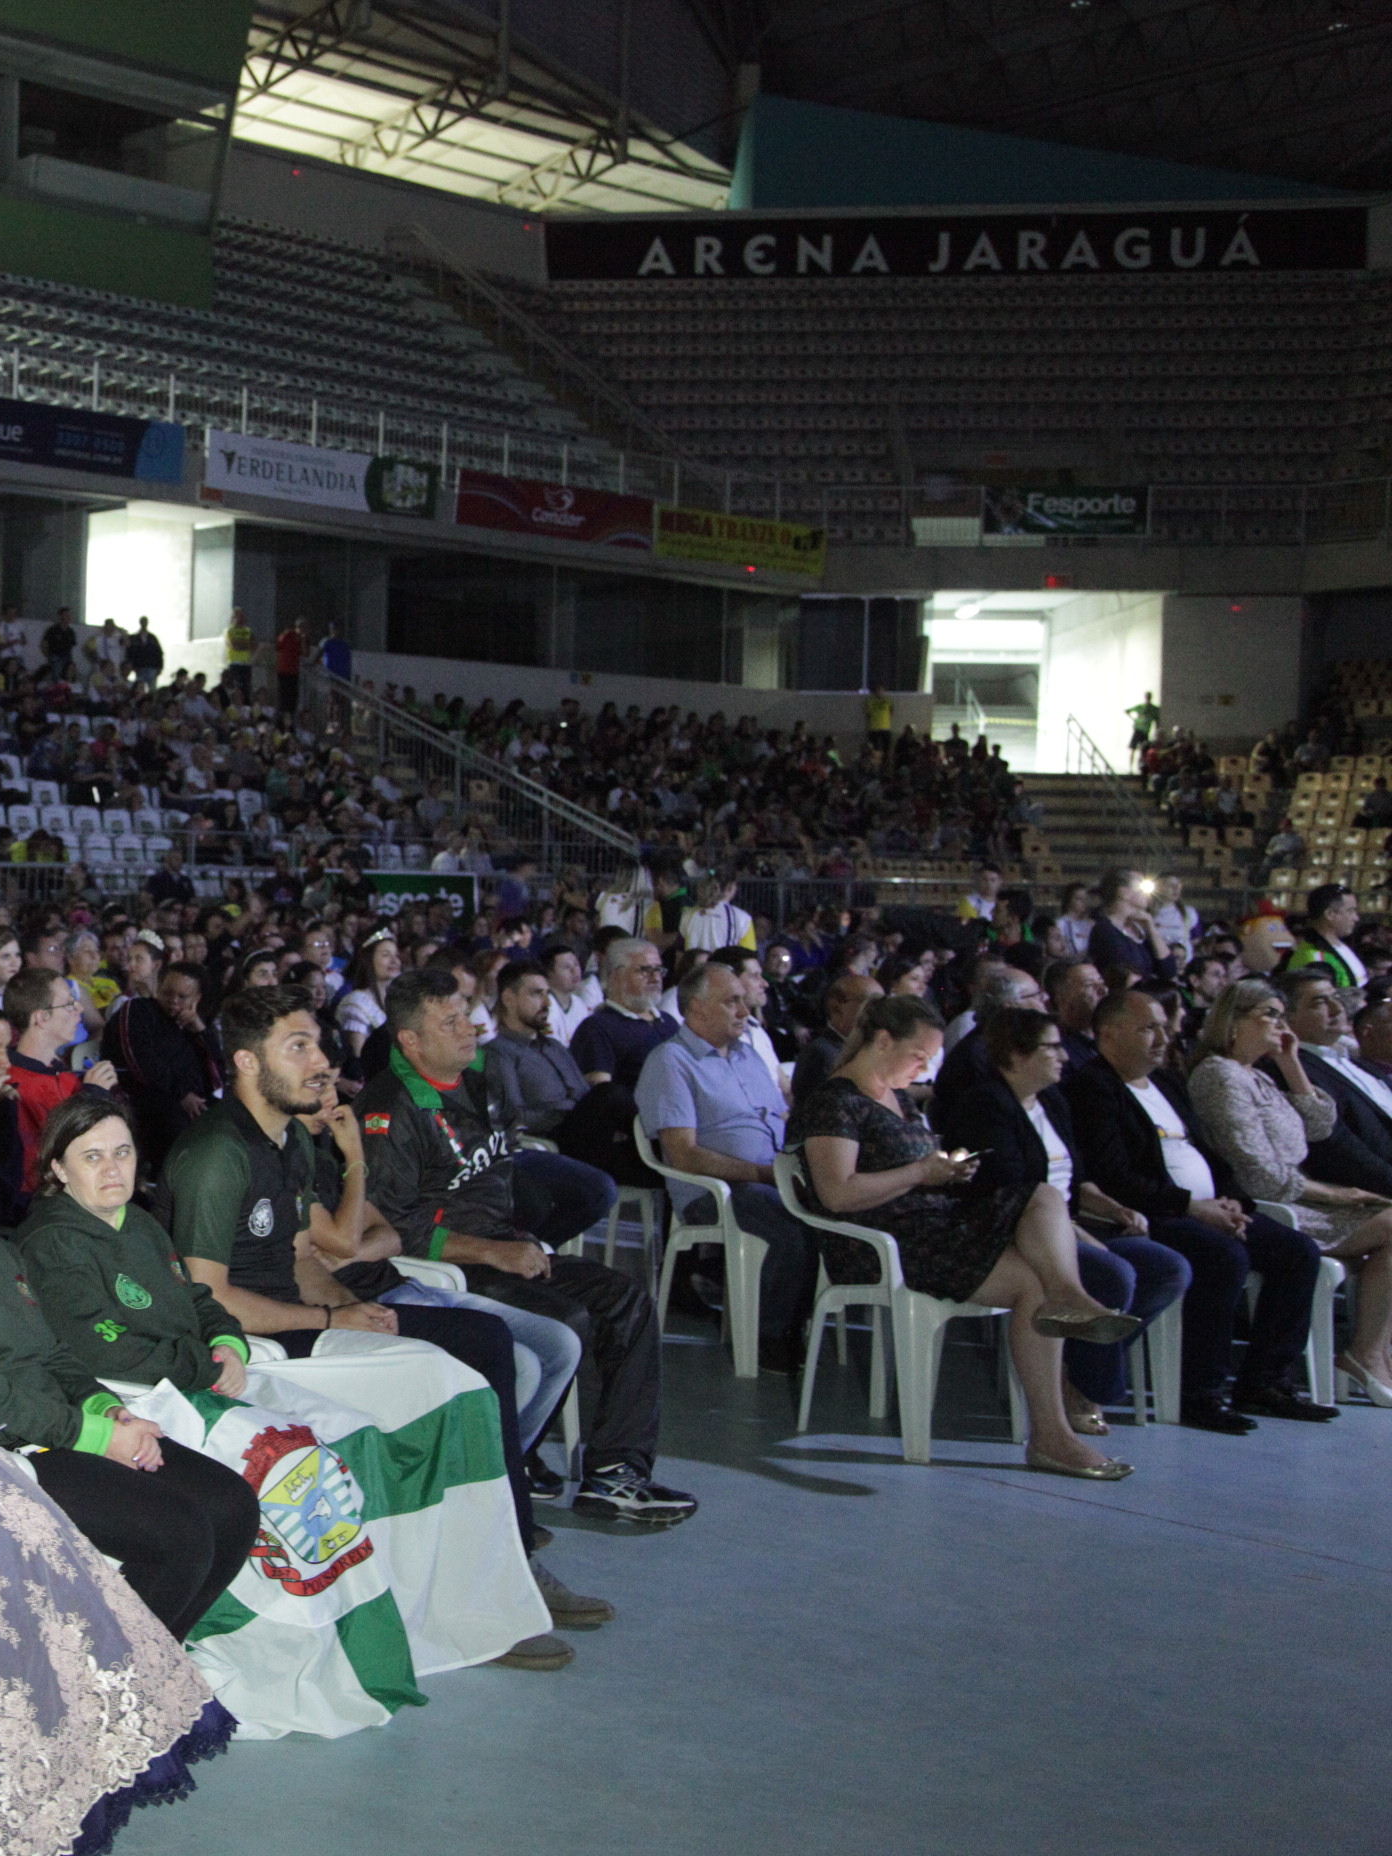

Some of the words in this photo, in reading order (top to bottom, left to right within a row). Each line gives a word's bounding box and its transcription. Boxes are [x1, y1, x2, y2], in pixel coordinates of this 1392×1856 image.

[636, 232, 892, 275] ARENA
[927, 216, 1262, 273] JARAGUÁ
[1026, 491, 1137, 518] Fesporte
